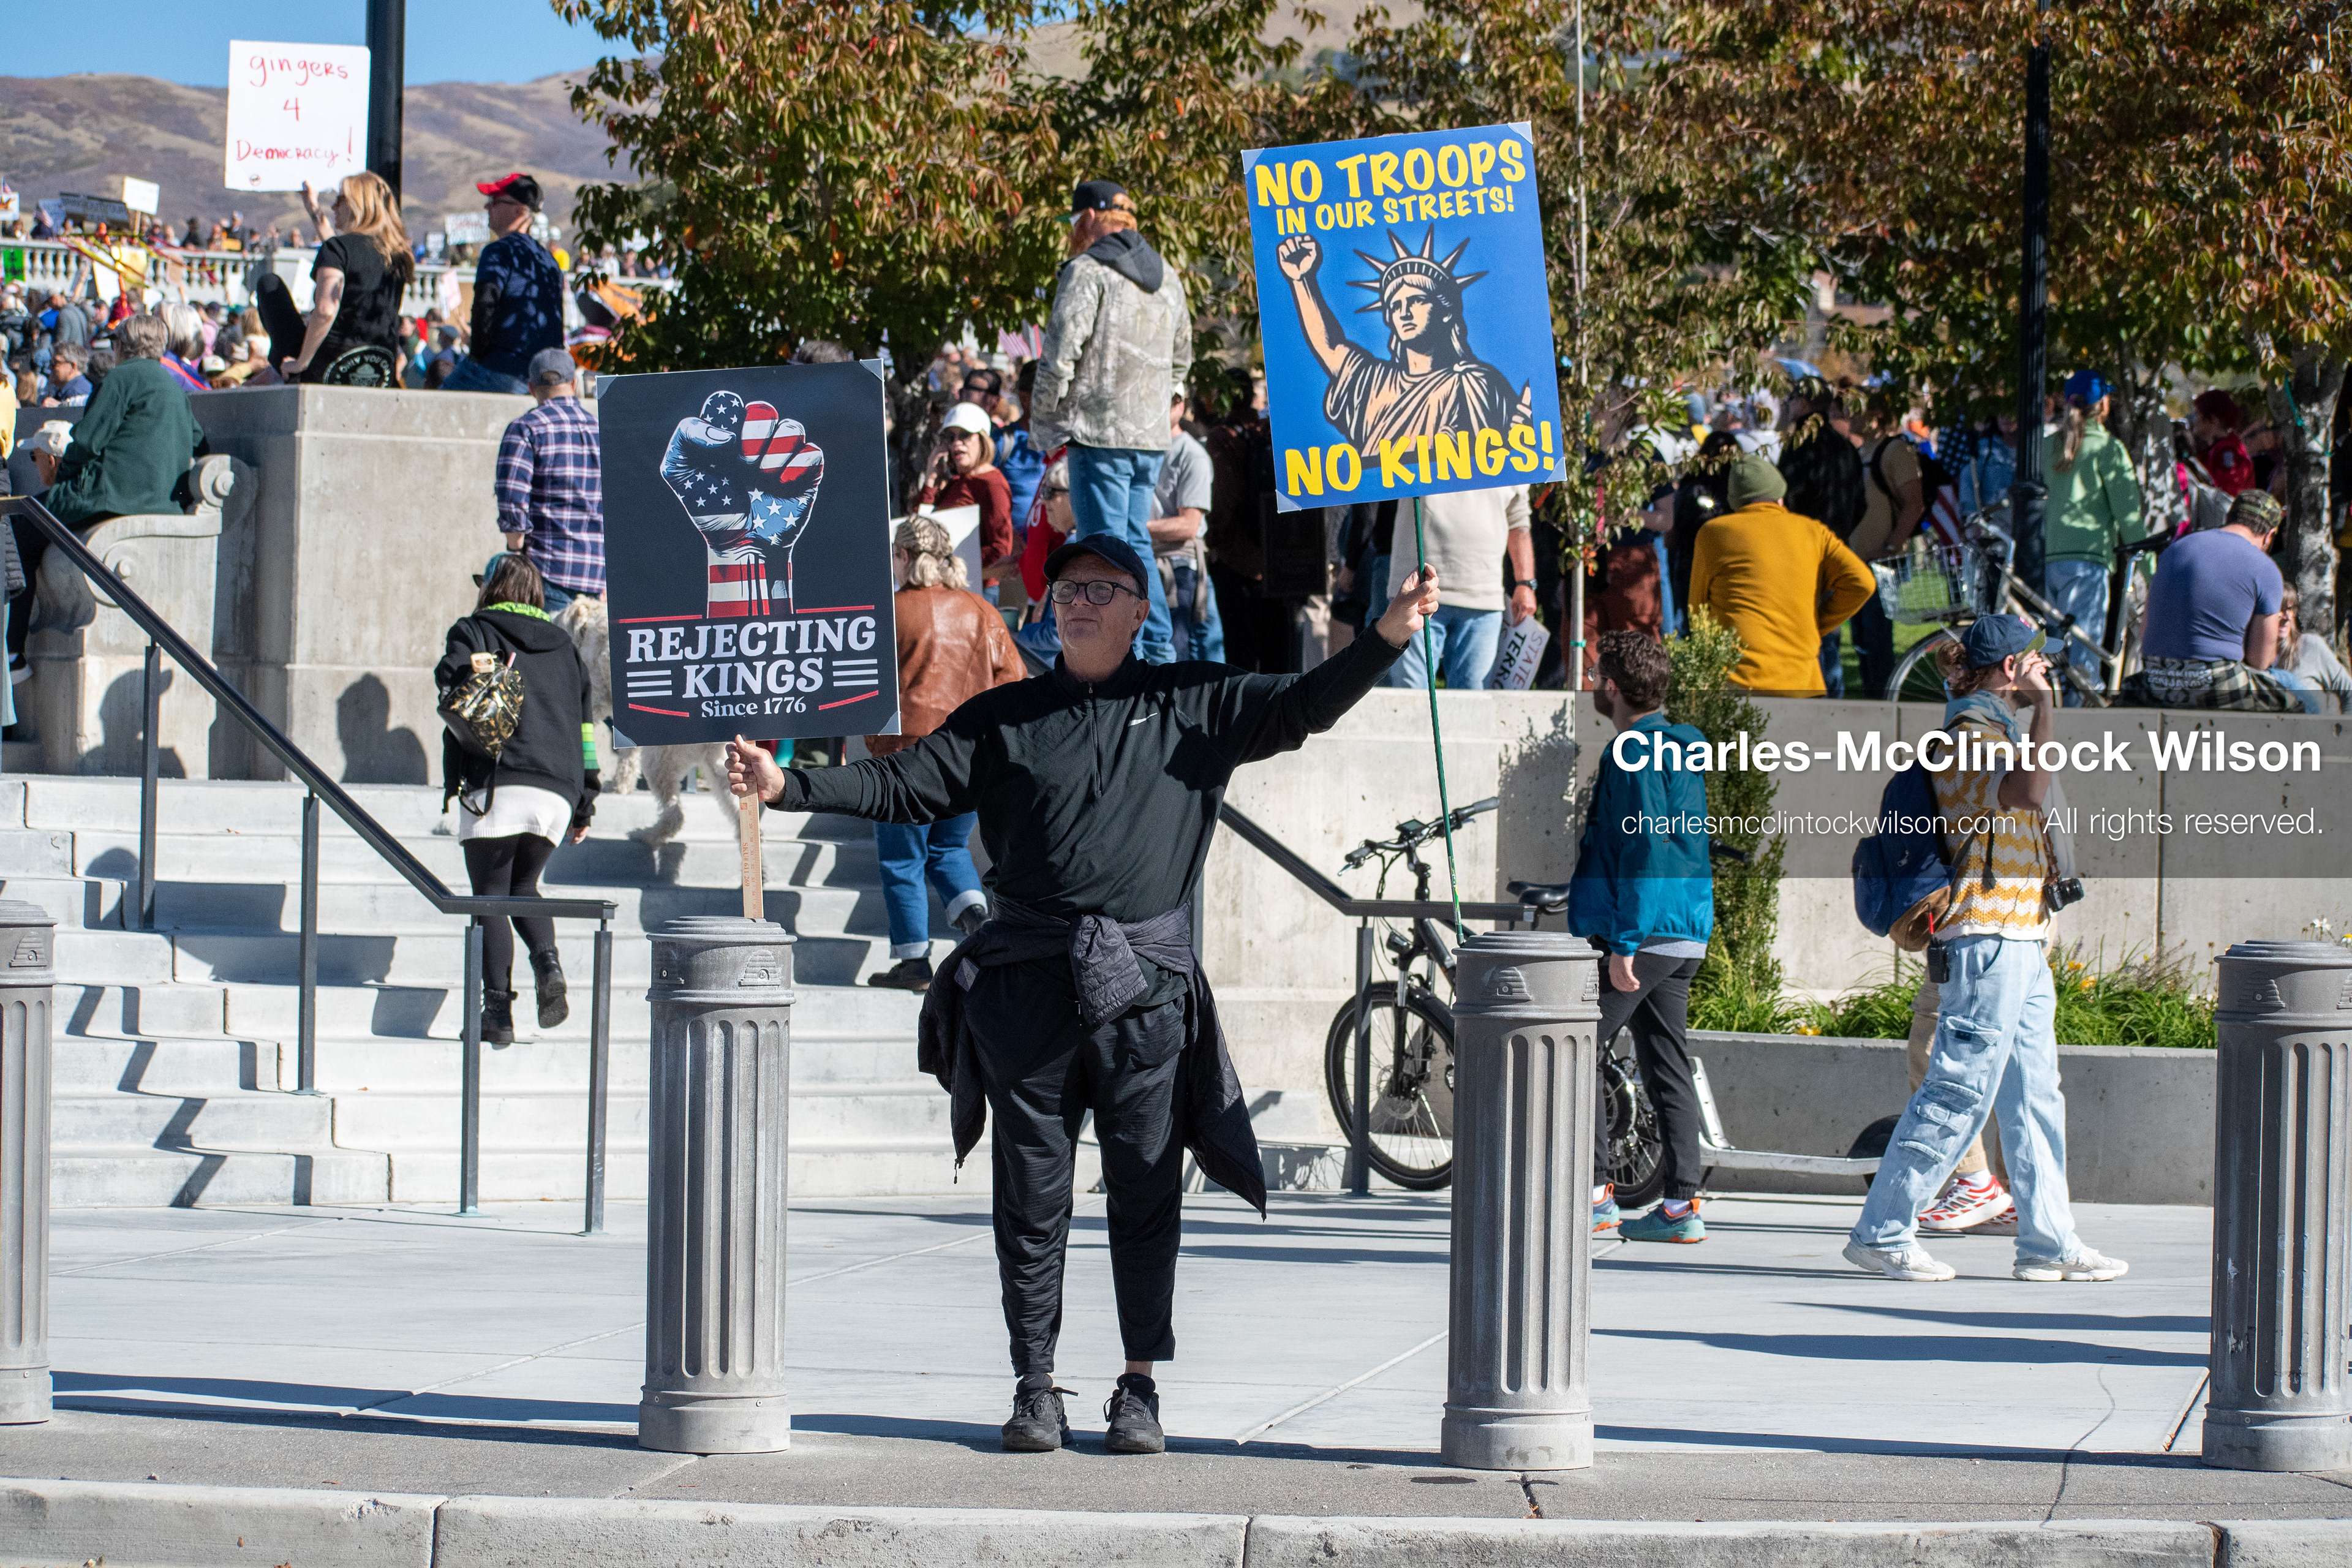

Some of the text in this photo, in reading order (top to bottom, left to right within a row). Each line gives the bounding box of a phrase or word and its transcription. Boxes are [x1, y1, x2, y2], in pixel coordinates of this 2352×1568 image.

[249, 56, 348, 88] gingers
[284, 97, 300, 121] 4
[1254, 139, 1526, 206] NO TROOPS
[1276, 185, 1514, 235] IN OUR STREETS!
[1285, 421, 1555, 496] NO KINGS!
[625, 616, 876, 663] REJECTING
[682, 657, 823, 699] KINGS
[701, 696, 807, 718] Since 1776
